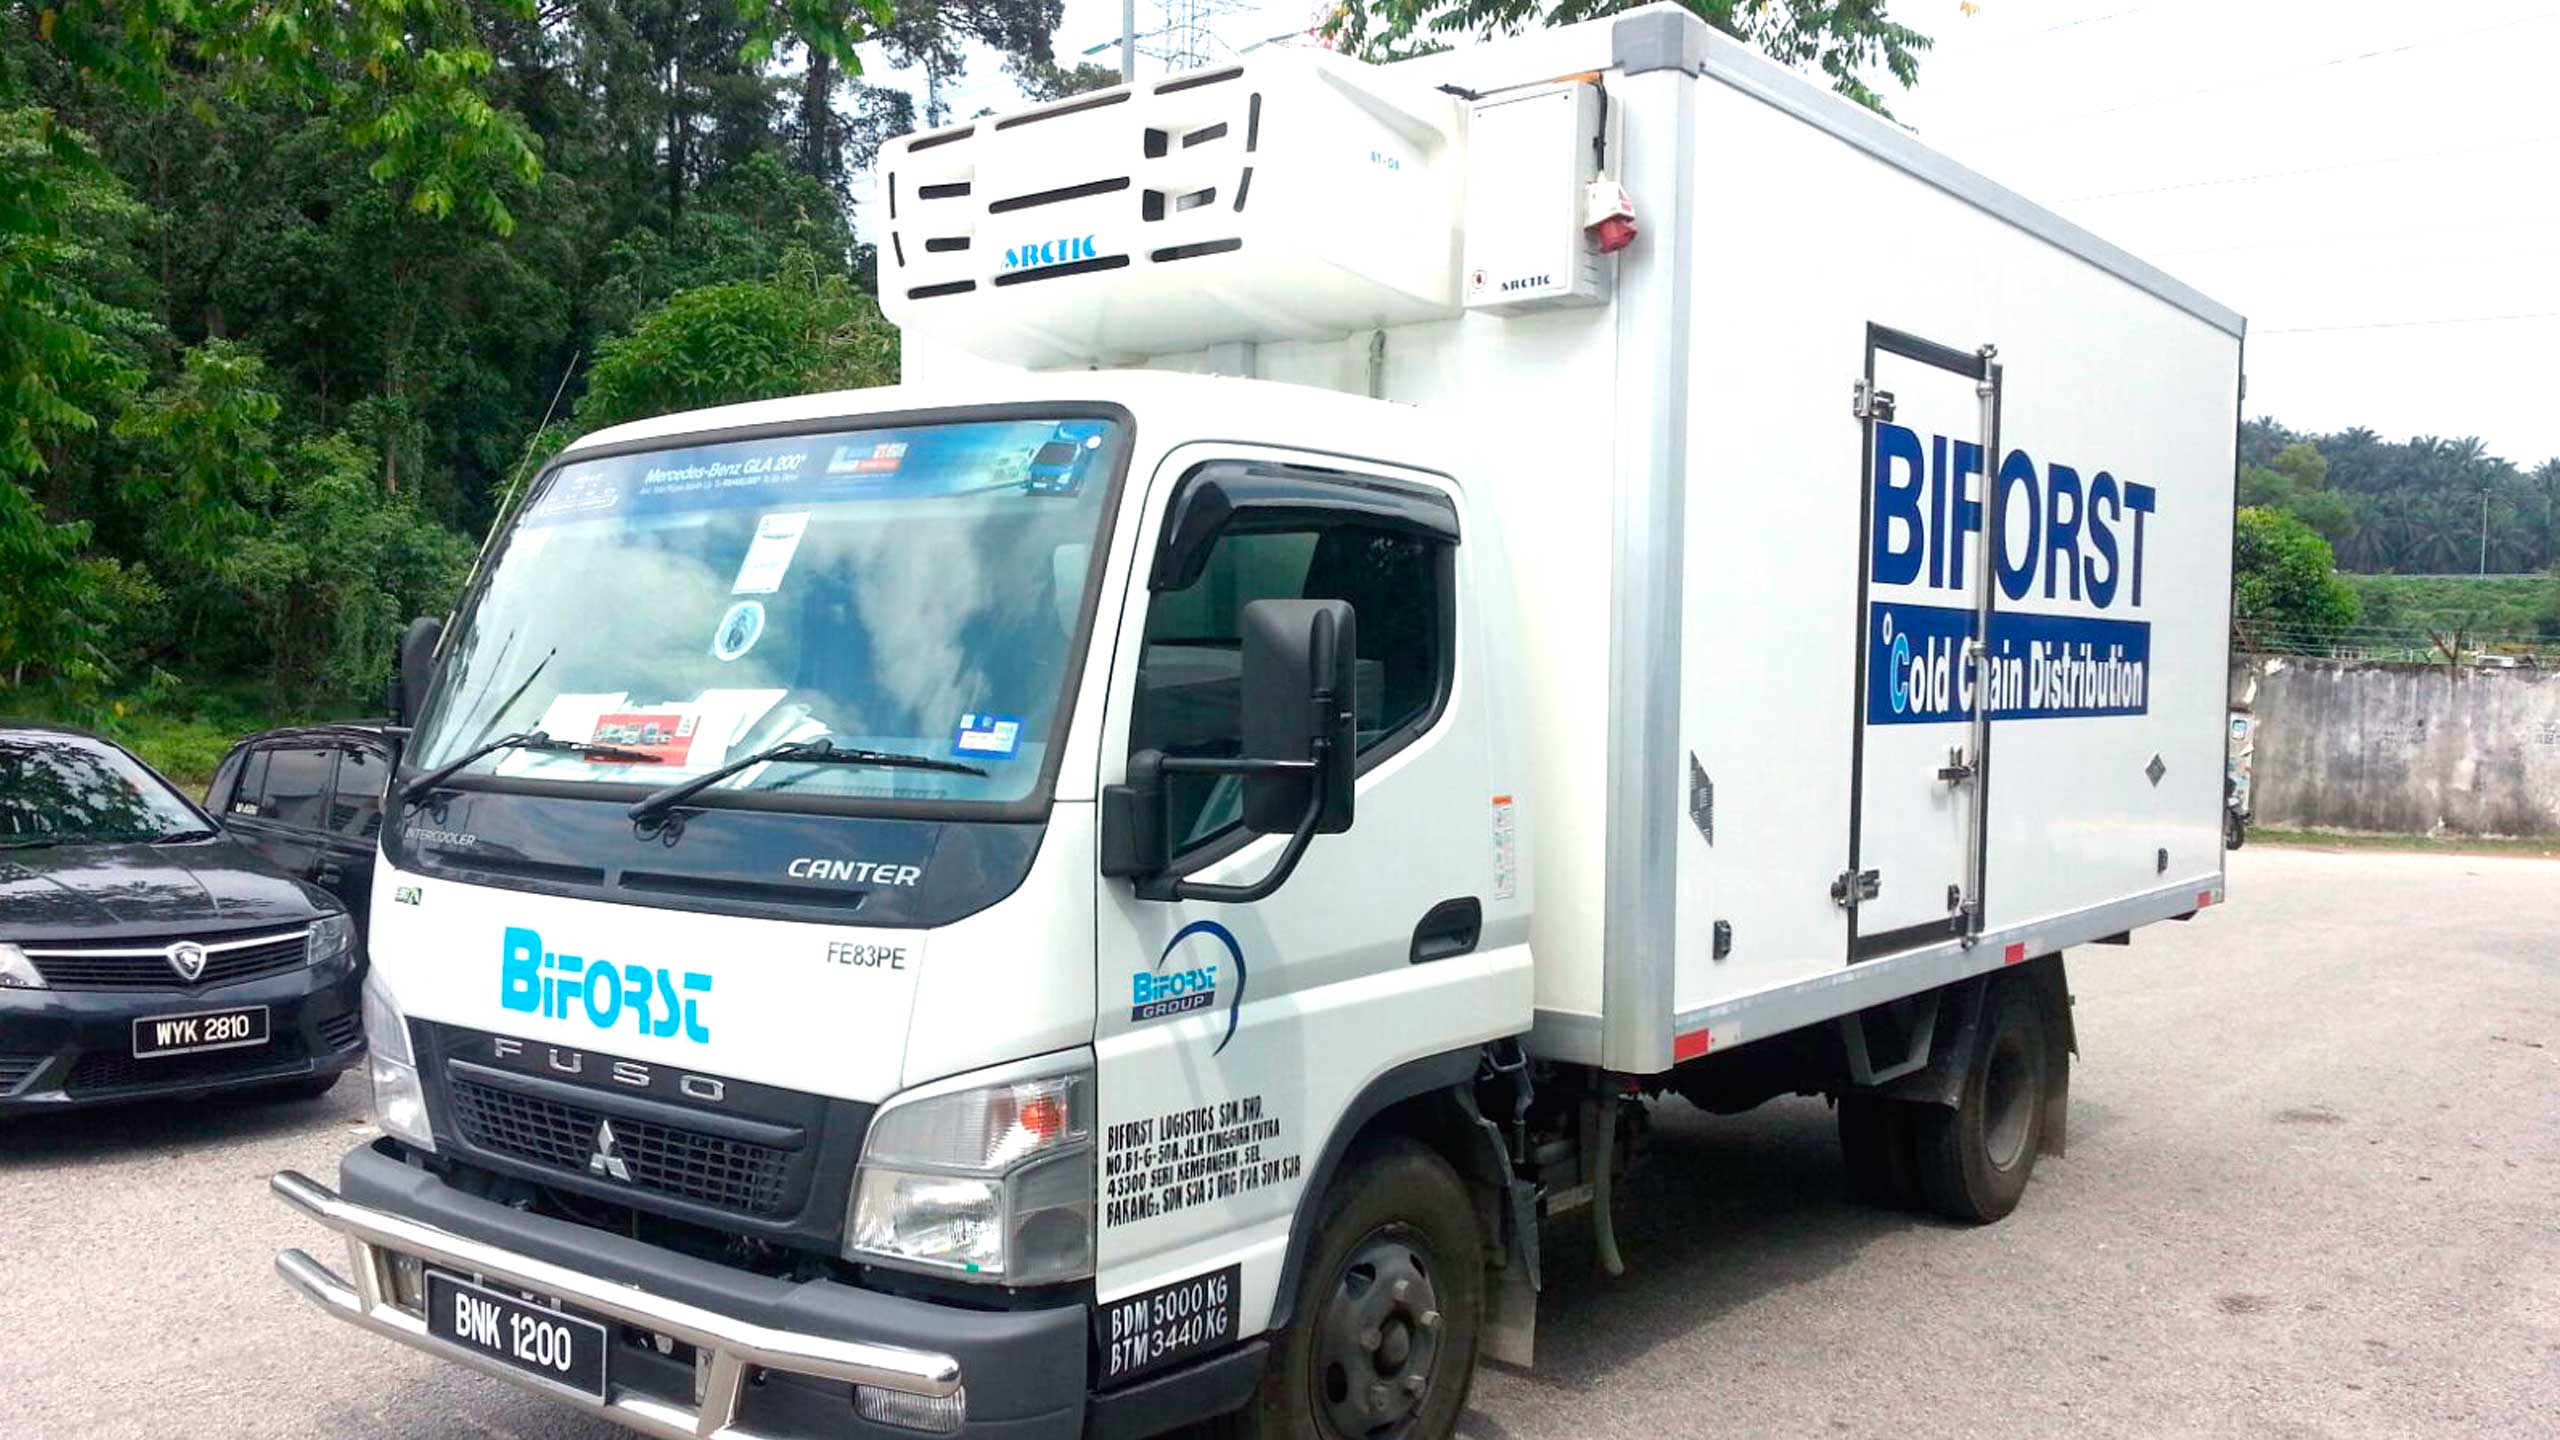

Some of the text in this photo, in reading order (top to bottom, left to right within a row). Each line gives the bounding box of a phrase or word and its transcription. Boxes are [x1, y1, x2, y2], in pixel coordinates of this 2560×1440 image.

[1000, 234, 1097, 269] ARCTIC
[1501, 274, 1551, 292] ARCTIC
[645, 462, 742, 484] Mercedes-Benz
[743, 457, 773, 474] GLA
[1871, 421, 2156, 609] BIFORST
[2029, 640, 2143, 711] Distribution
[788, 858, 921, 886] CANTER
[827, 941, 907, 970] FE83PE
[1143, 995, 1204, 1018] GROUP
[156, 1015, 249, 1046] WYK 2810
[495, 1038, 724, 1101] FUSO
[1108, 1119, 1154, 1152] BIFORST
[1160, 1106, 1214, 1141] LOGISTICS
[1252, 1118, 1280, 1142] PUTRA
[1107, 1173, 1146, 1199] 43300
[1151, 1165, 1174, 1187] SERI
[1163, 1185, 1183, 1214] SDN
[1207, 1178, 1214, 1201] 3
[1217, 1172, 1236, 1199] ORG
[1261, 1160, 1280, 1187] SDN
[1112, 1275, 1227, 1341] BDM 5000 KG
[455, 1292, 572, 1372] BNK 1200
[1110, 1307, 1228, 1376] BTM 3440 KG
